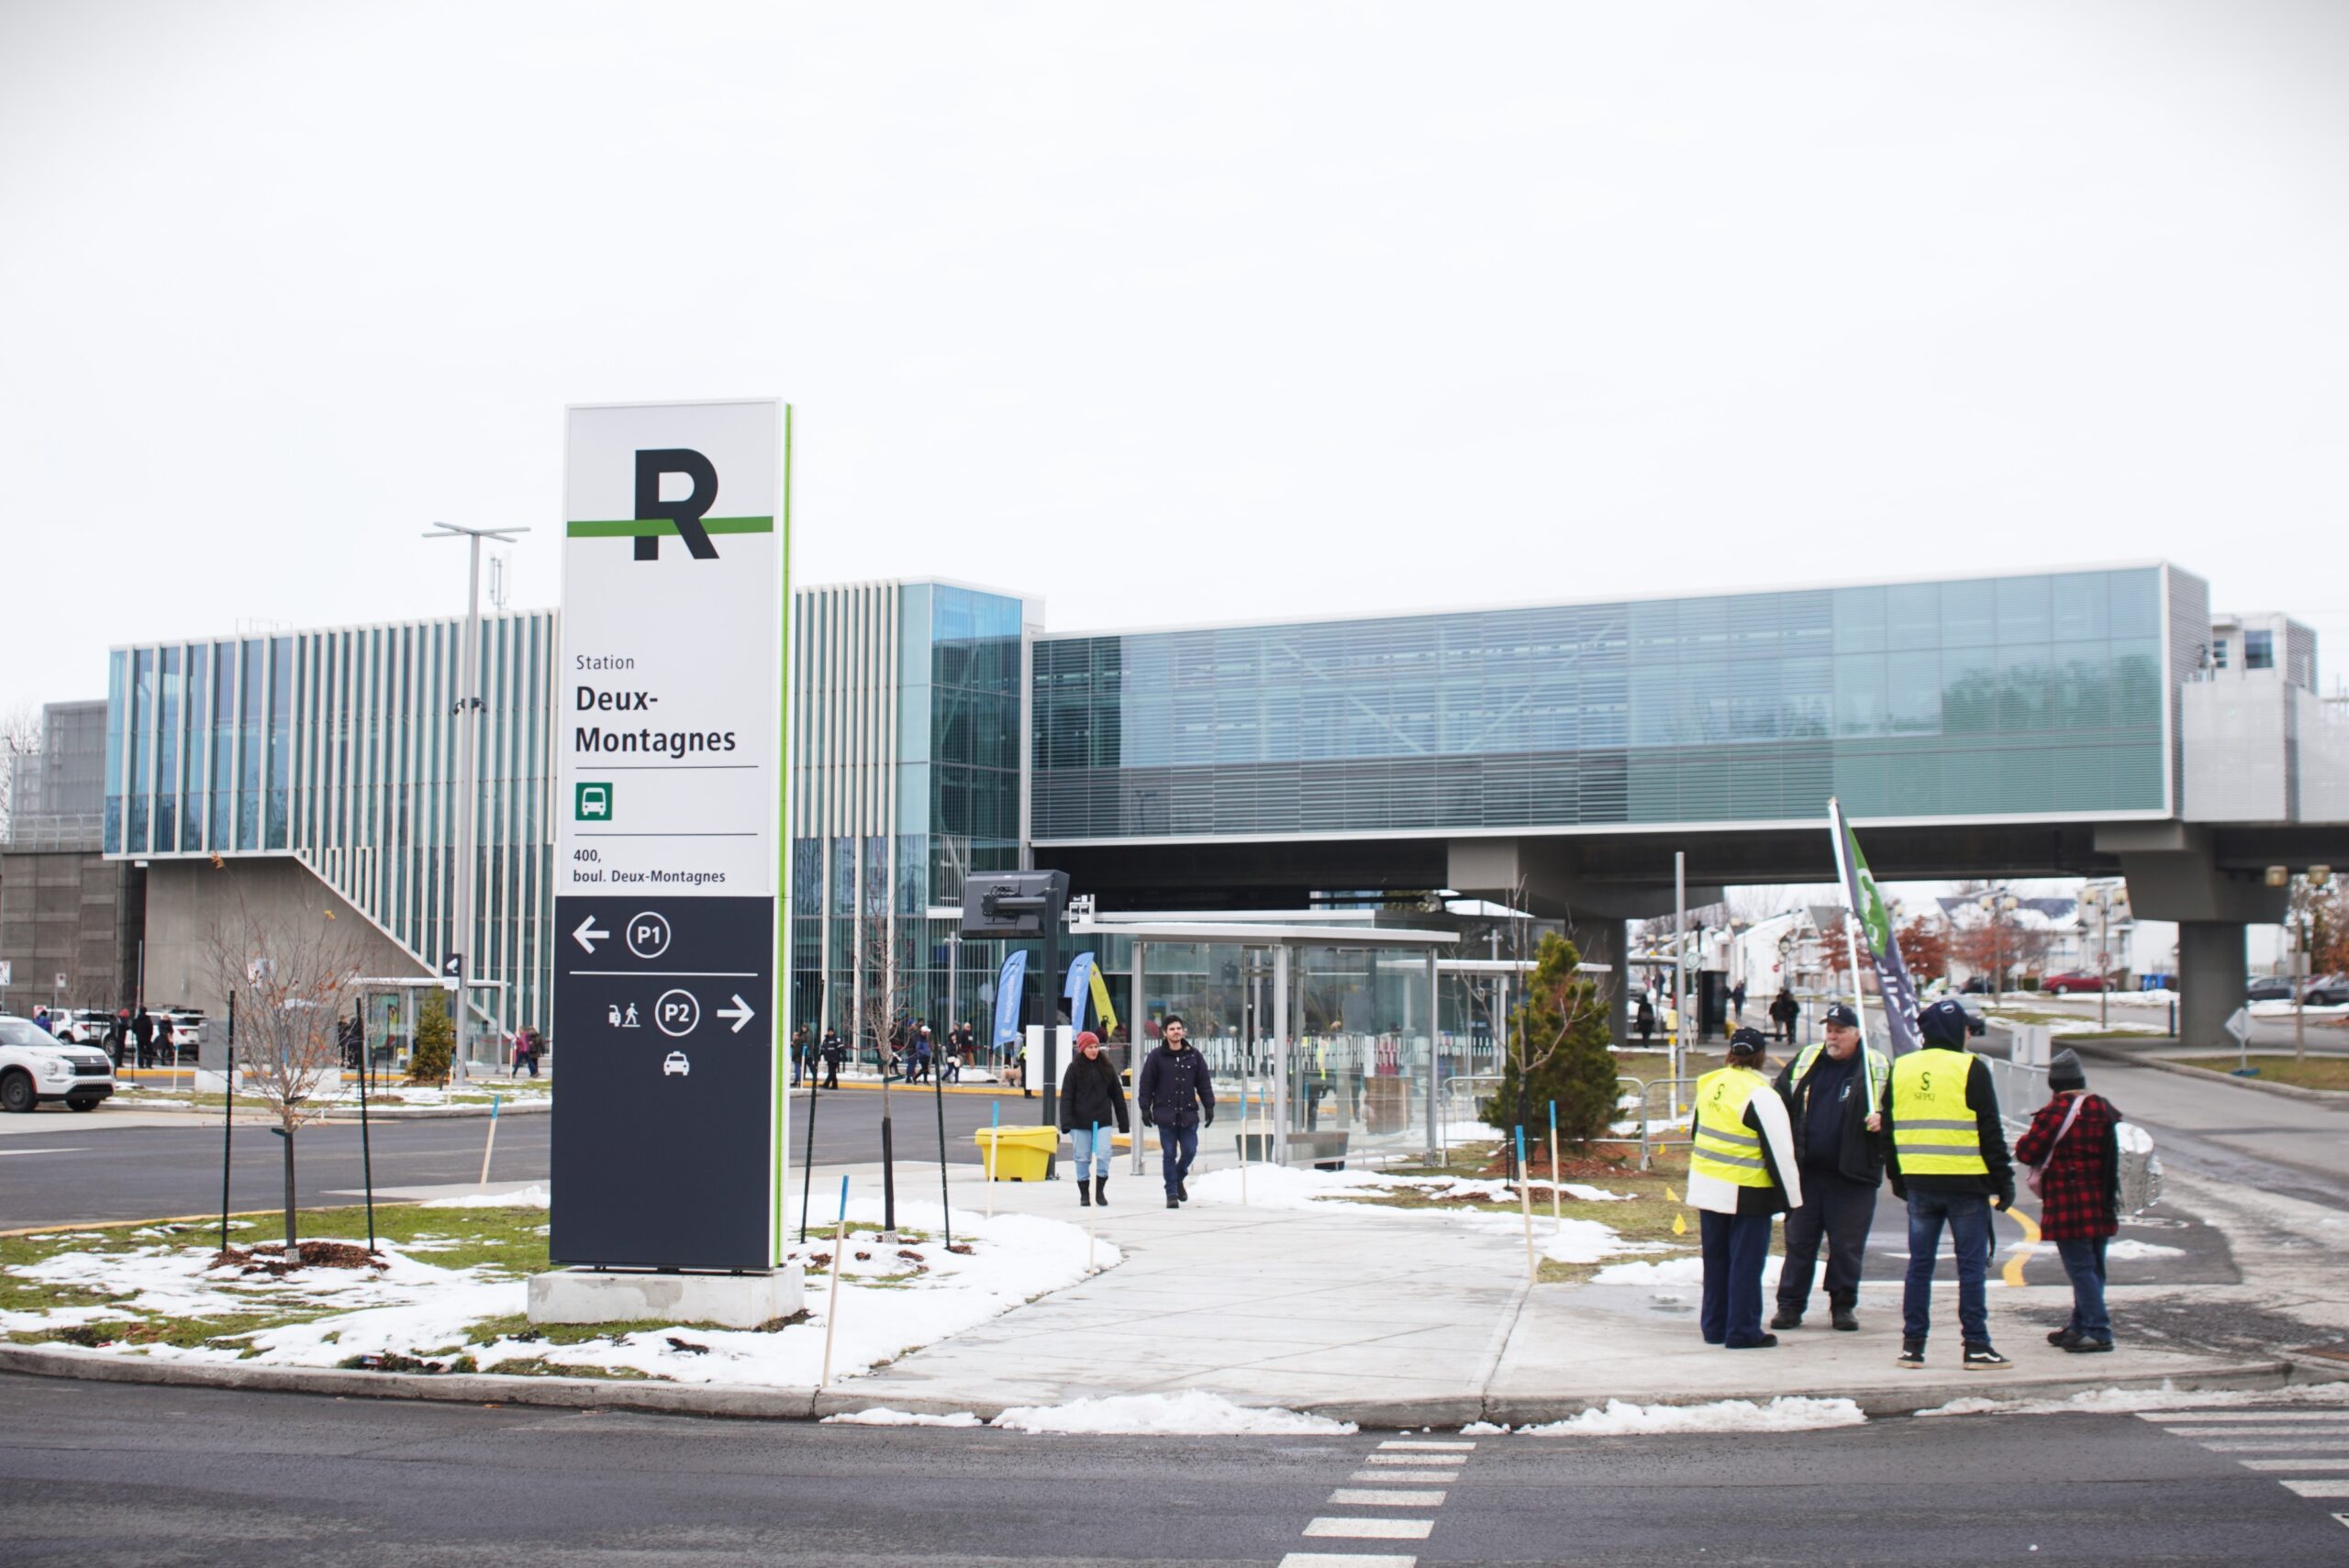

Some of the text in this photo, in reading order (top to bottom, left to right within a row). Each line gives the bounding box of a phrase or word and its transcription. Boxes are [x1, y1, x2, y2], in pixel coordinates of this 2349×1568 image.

[634, 448, 719, 562] R
[575, 654, 635, 671] Station
[576, 685, 659, 711] Deux-
[575, 727, 737, 760] Montagnes
[573, 849, 602, 865] 400,
[573, 869, 726, 886] boul. Deux-Montagnes
[637, 926, 660, 944] P1
[664, 1003, 690, 1022] P2
